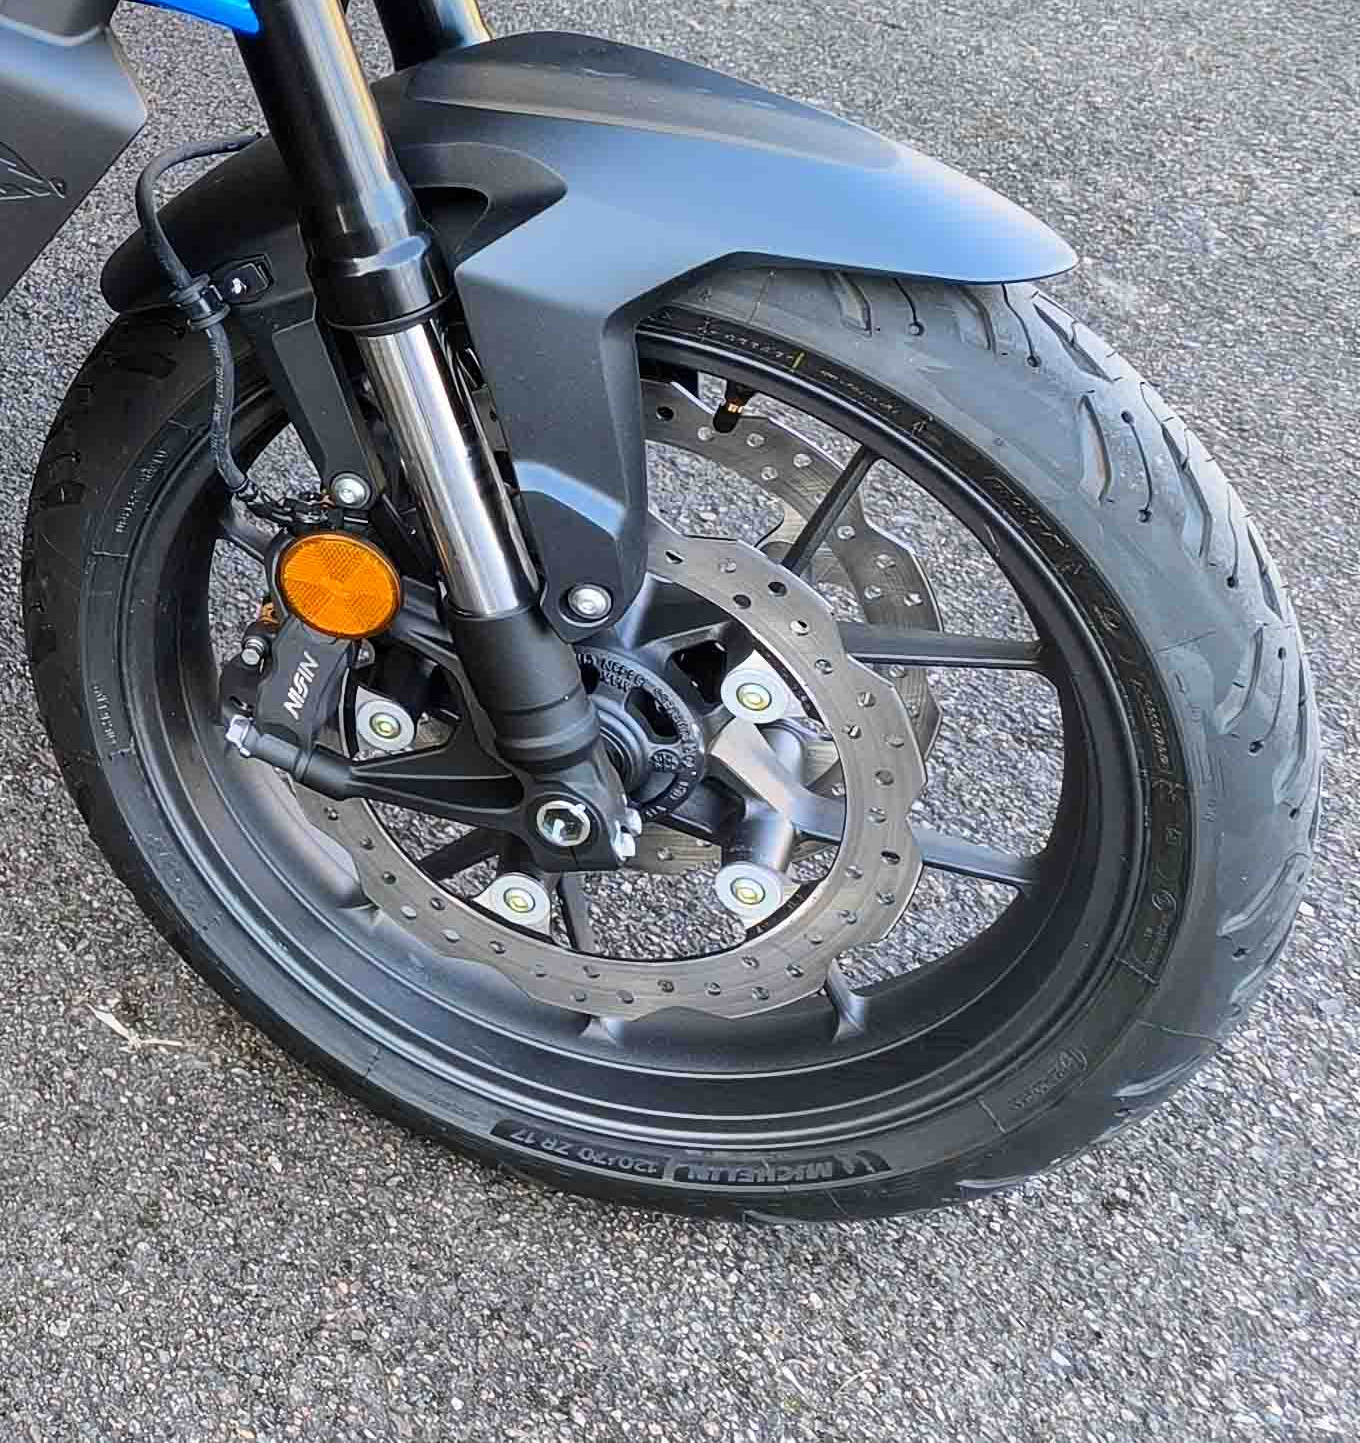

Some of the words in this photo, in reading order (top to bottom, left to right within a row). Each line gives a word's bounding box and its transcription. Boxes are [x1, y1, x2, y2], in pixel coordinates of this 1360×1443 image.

[283, 650, 319, 720] NISSIN
[510, 1128, 536, 1145] 17
[540, 1134, 570, 1156] ZR
[581, 1146, 658, 1174] 120/70
[685, 1159, 834, 1184] MICHELIN
